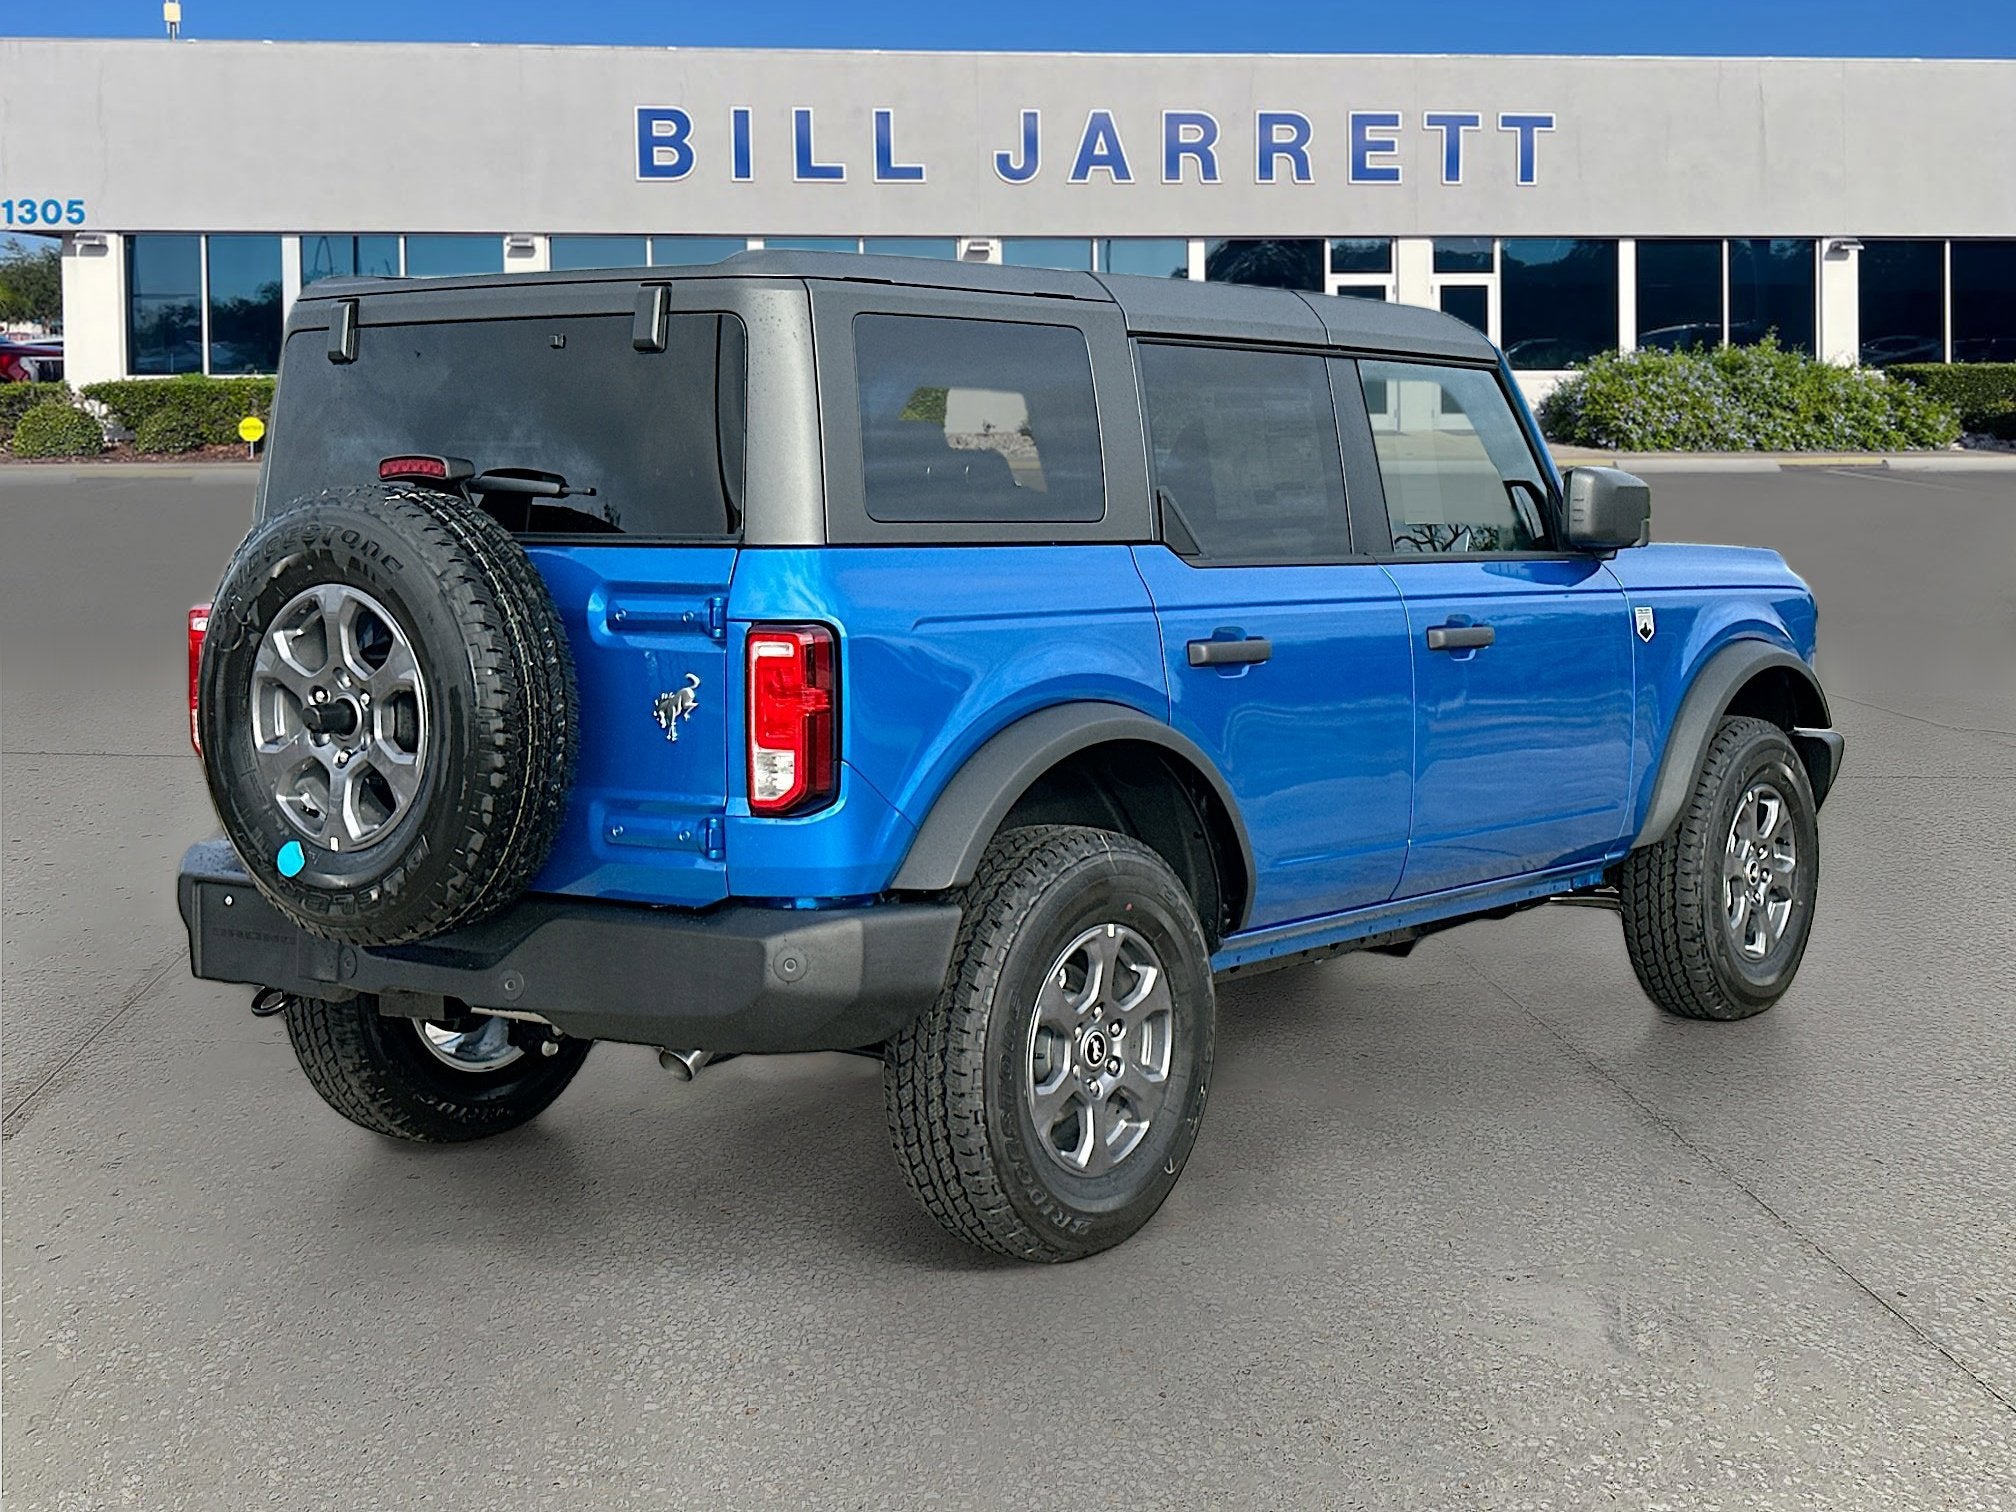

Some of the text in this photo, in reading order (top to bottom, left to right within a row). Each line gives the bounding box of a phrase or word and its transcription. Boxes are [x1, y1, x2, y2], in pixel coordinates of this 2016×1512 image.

[636, 106, 1555, 185] BILL JARRETT
[1, 198, 86, 225] 1305
